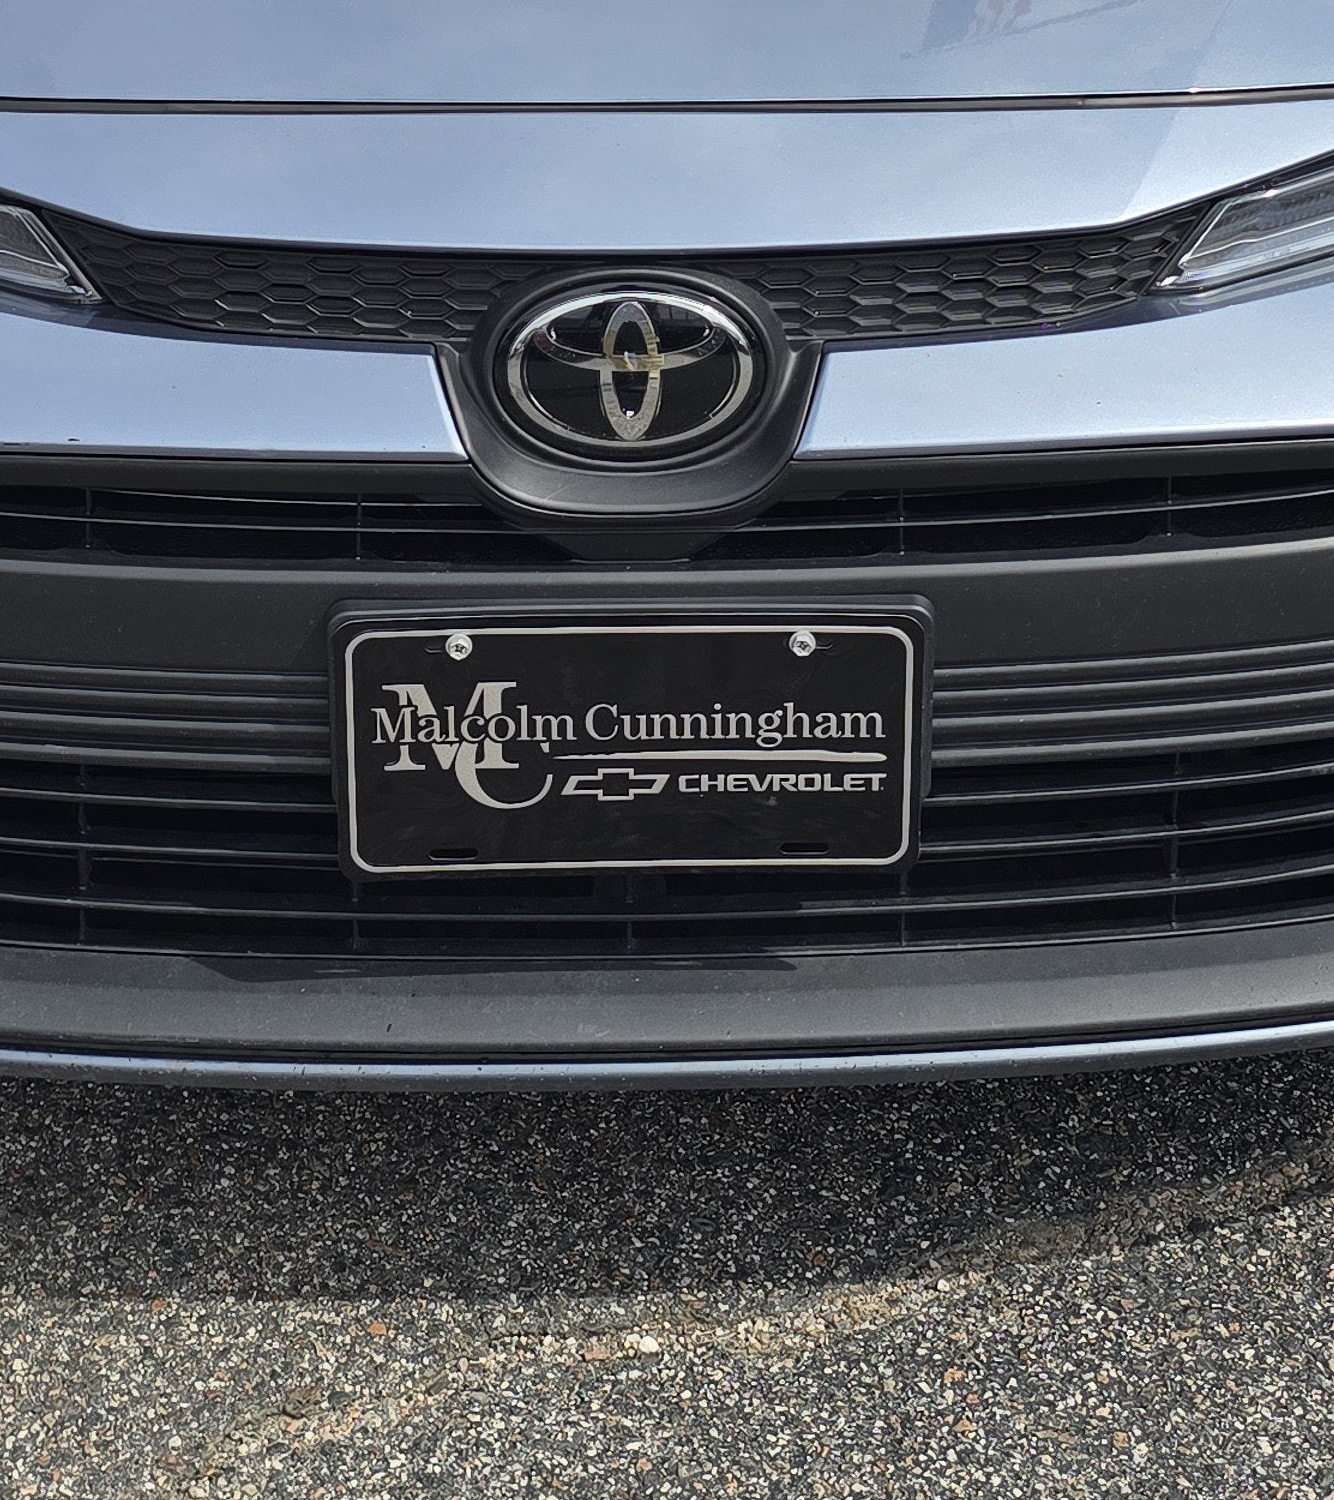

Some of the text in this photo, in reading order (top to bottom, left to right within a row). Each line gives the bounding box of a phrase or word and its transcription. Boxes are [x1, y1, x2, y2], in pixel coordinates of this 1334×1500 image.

[370, 701, 887, 748] Malcolm Cunningham
[677, 772, 887, 793] CHEVROLET
